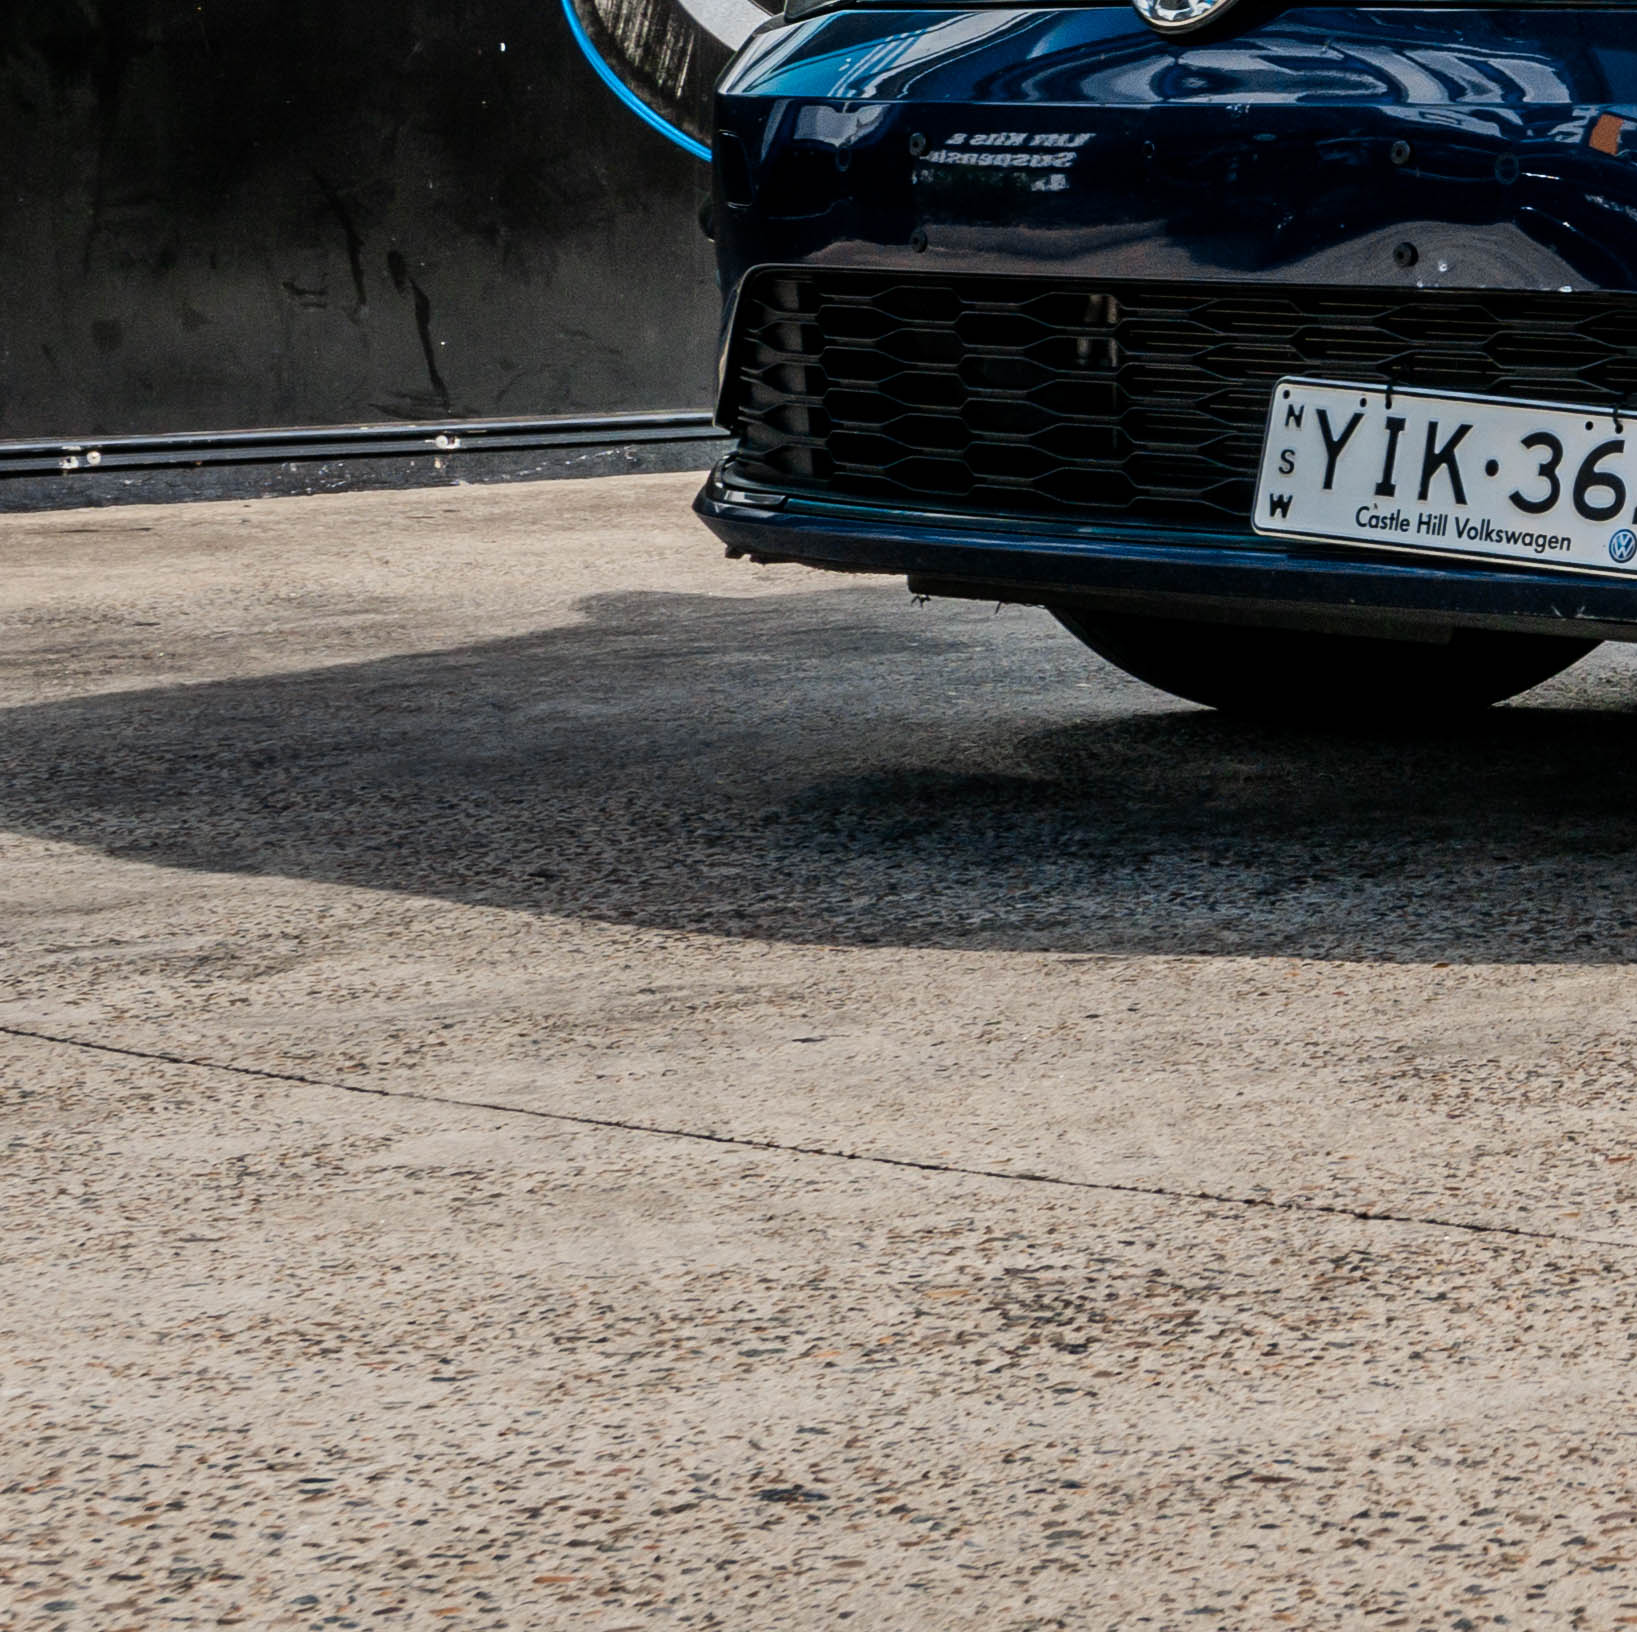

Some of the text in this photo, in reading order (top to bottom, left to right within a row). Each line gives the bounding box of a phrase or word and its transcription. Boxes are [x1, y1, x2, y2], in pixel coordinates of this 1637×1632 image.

[1355, 505, 1572, 554] Castle Hill Volkswagen
